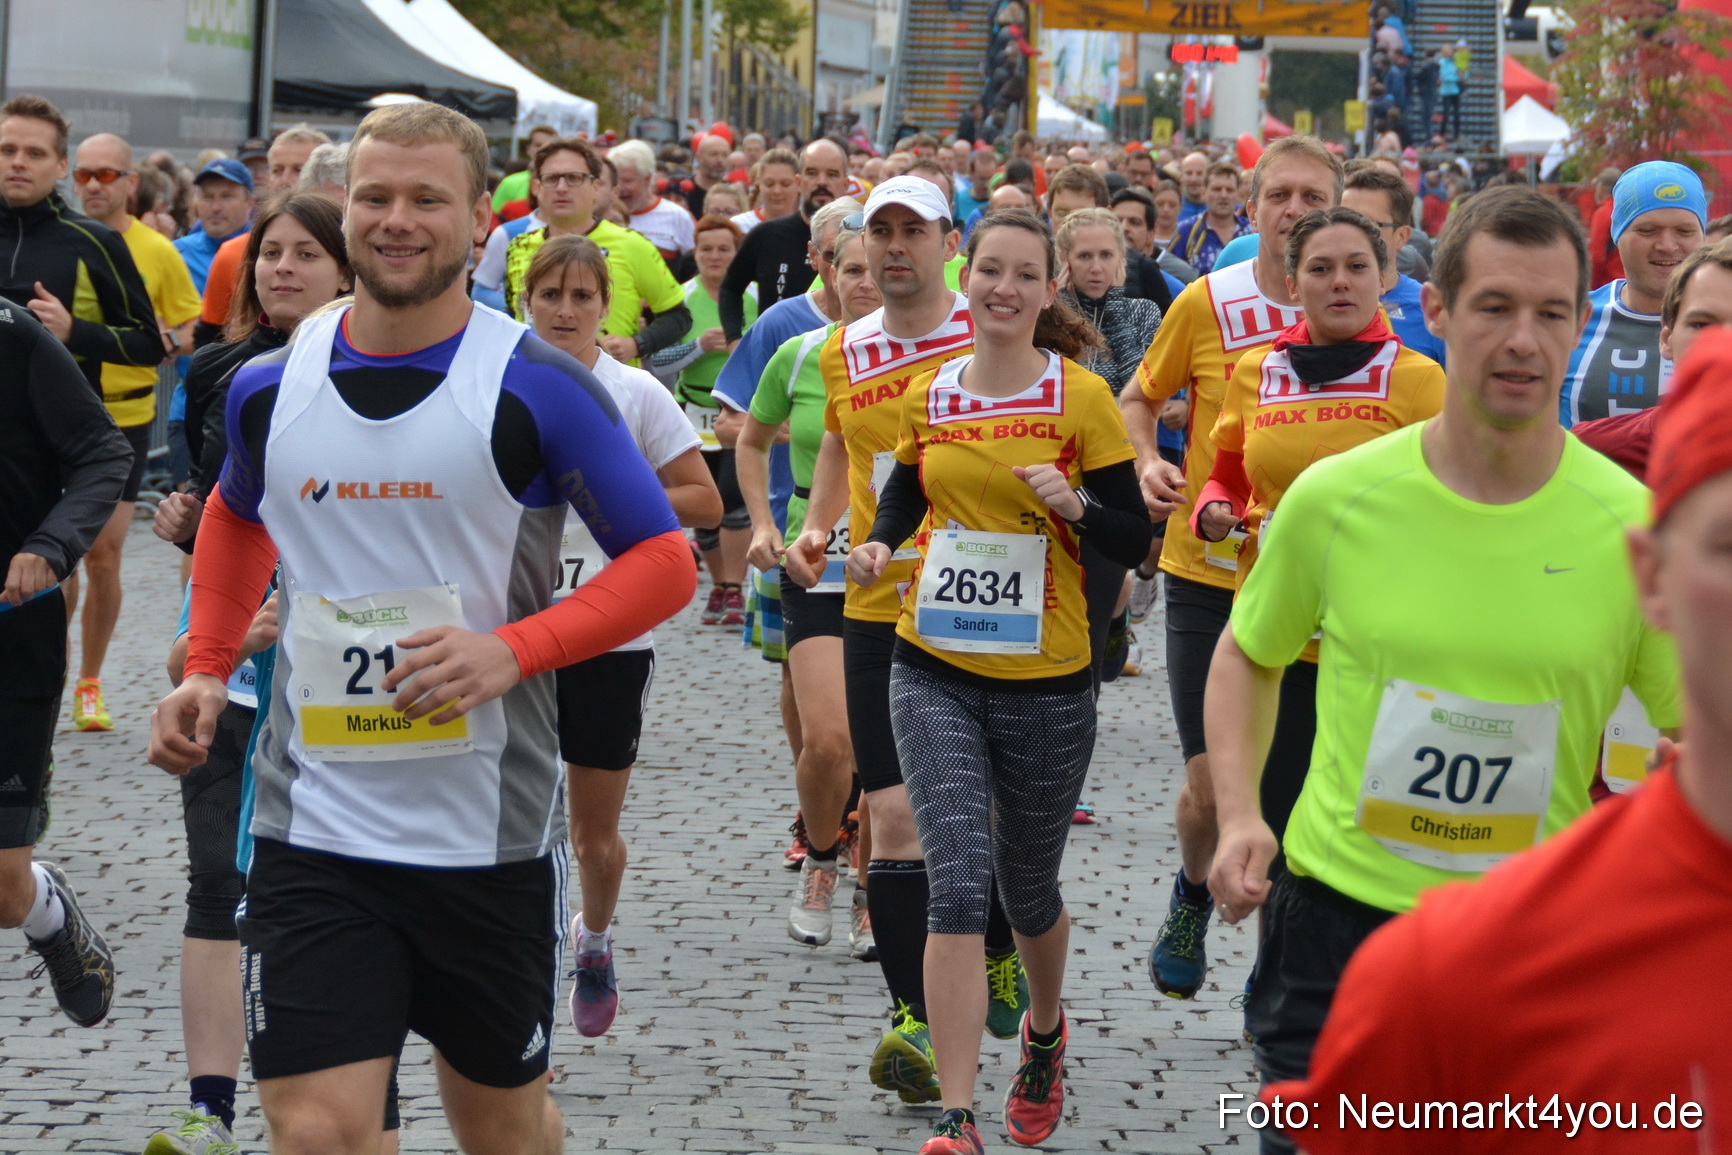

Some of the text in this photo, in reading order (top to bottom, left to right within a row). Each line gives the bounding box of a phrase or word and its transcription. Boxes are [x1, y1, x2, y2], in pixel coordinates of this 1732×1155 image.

[1169, 2, 1241, 30] ZIEL
[851, 375, 912, 412] MAX
[1253, 402, 1388, 430] MAX BÖGL
[928, 419, 1063, 445] MAX BÖGL
[337, 482, 444, 499] KLEBL
[966, 542, 1008, 555] BOCK
[934, 567, 1023, 607] 2634
[350, 606, 408, 624] BOCK
[954, 616, 998, 632] Sandra
[347, 714, 412, 732] Markus
[1449, 711, 1514, 734] BOCK
[1408, 745, 1513, 805] 207
[1411, 815, 1492, 841] Christian
[250, 952, 262, 992] HORSE
